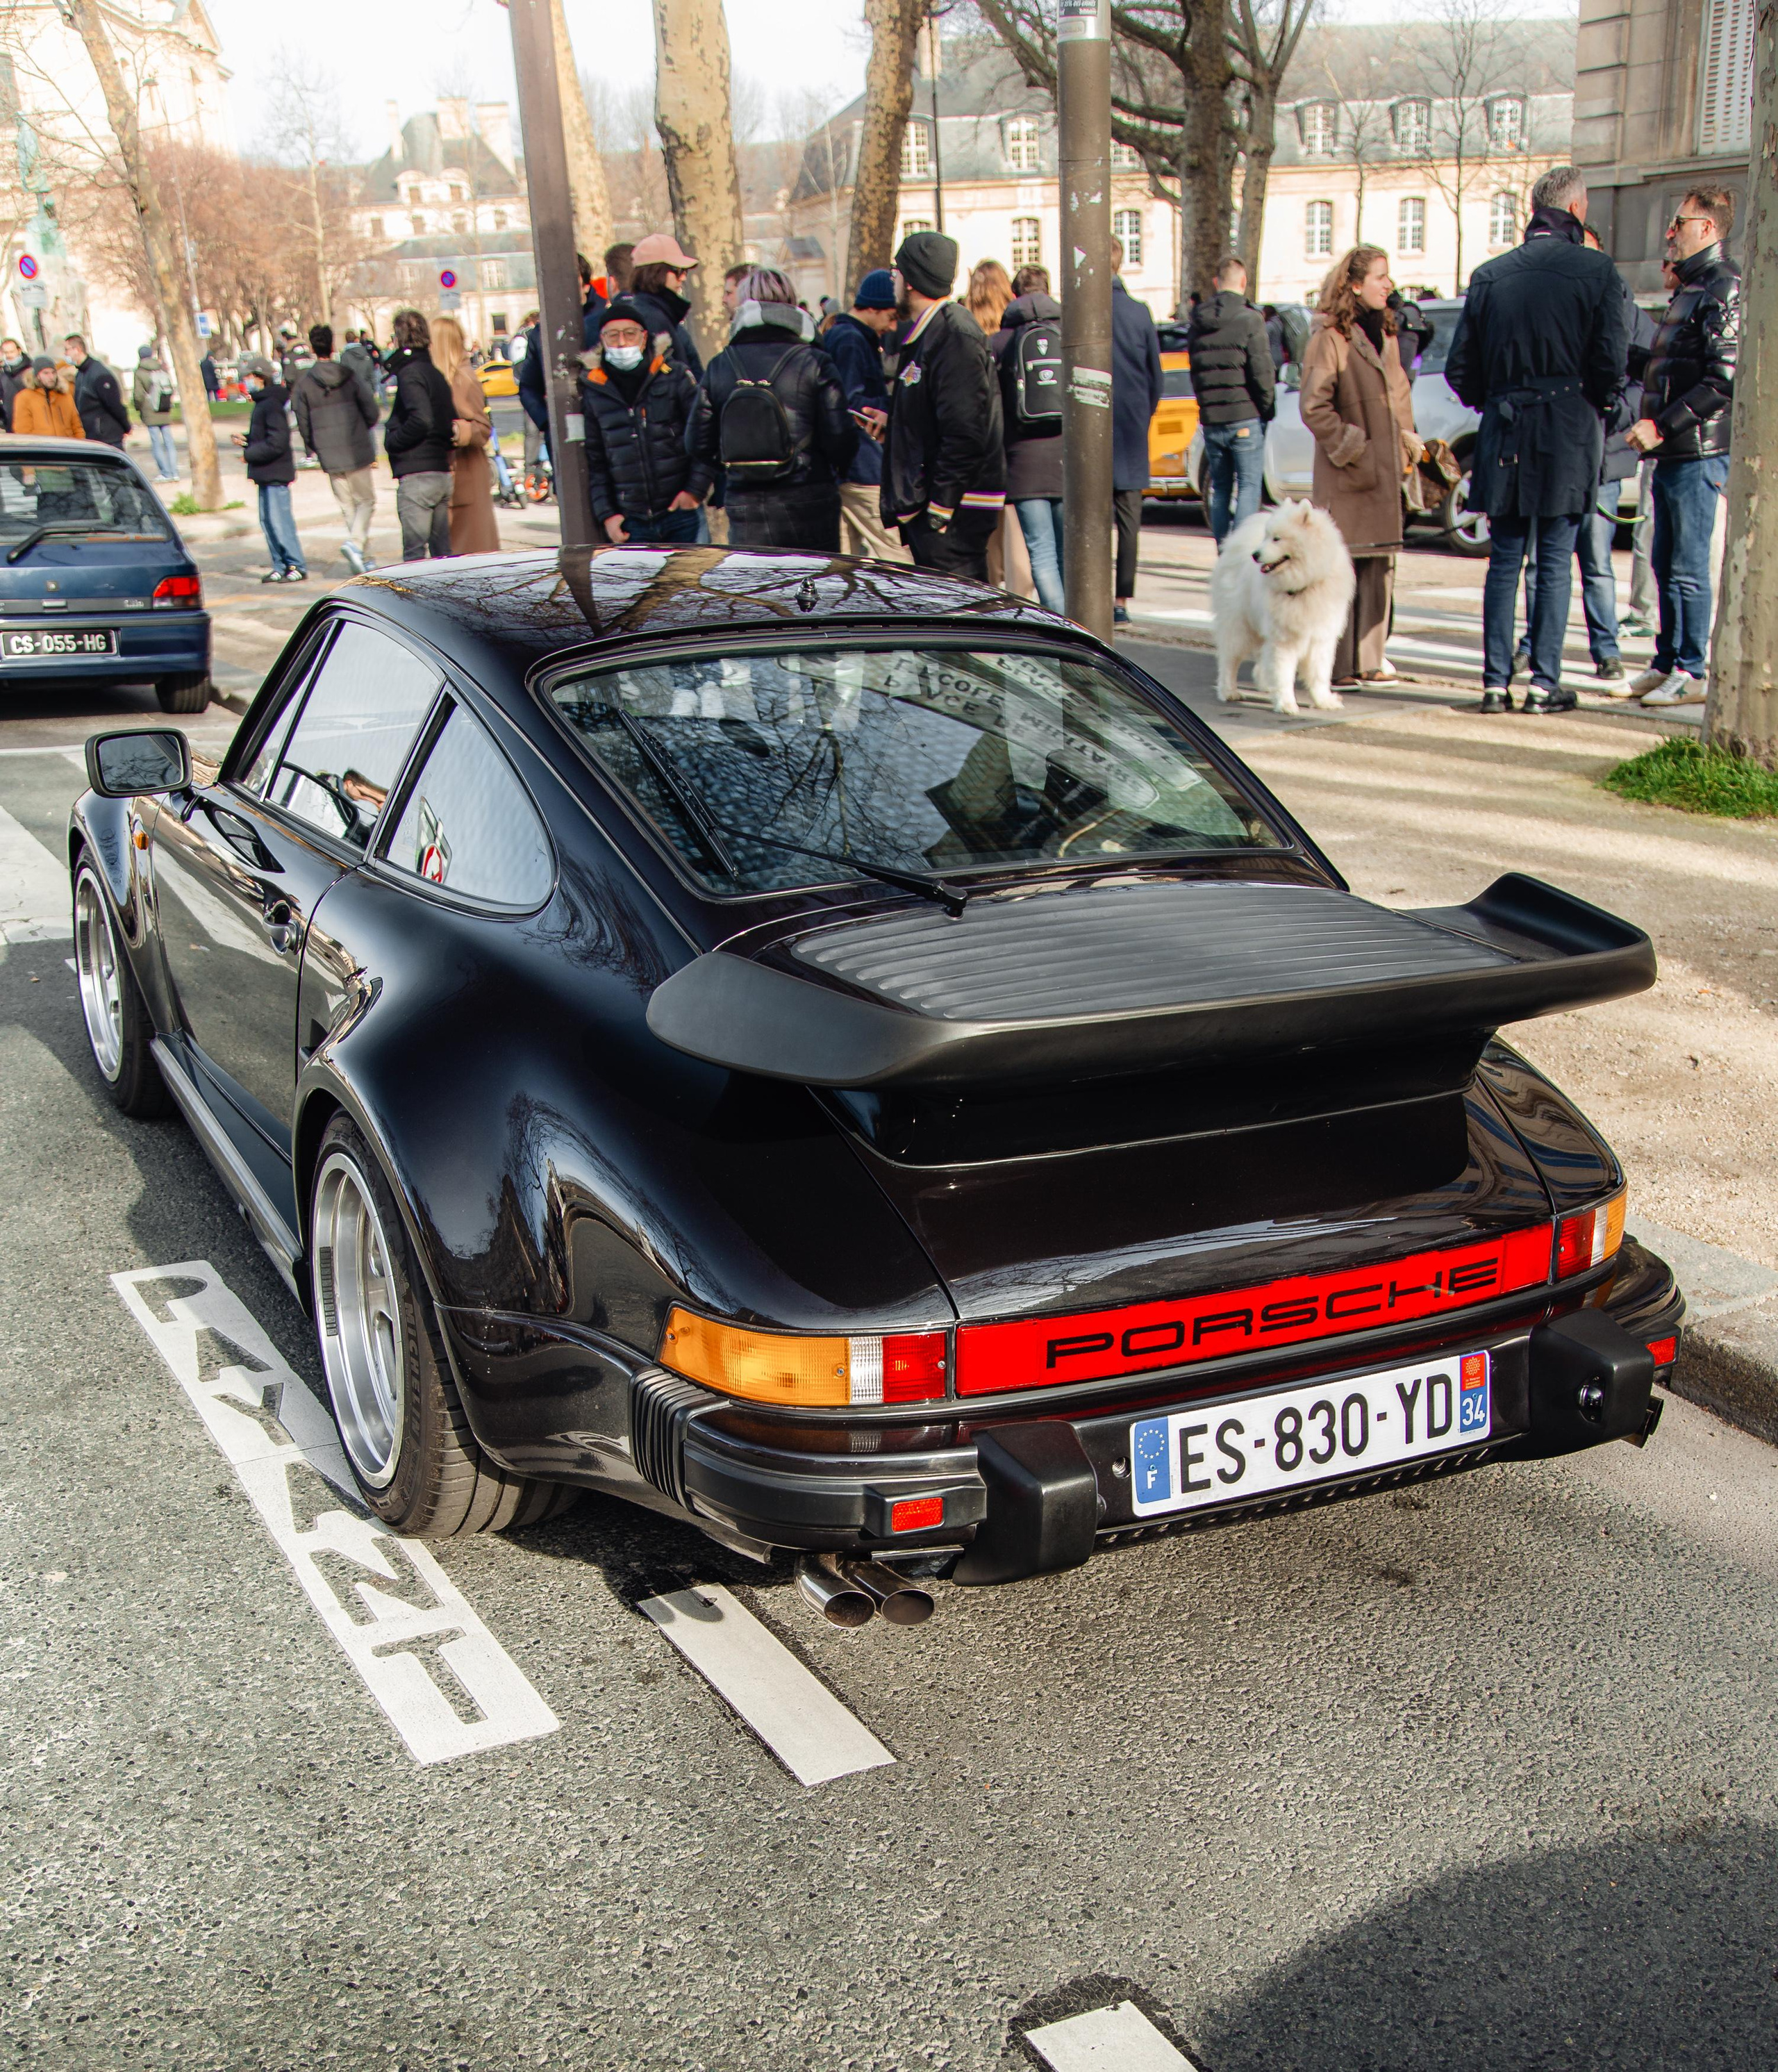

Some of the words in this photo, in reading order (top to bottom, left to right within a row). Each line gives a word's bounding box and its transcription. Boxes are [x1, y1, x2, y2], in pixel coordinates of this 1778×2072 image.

[10, 633, 106, 654] CS-055-HG
[404, 1301, 422, 1438] MICHELIN
[1045, 1256, 1499, 1370] PORSCHE
[1179, 1373, 1453, 1494] ES-830-YD
[1462, 1394, 1486, 1426] 34
[131, 1274, 489, 1725] PAYANT
[1146, 1469, 1158, 1490] F
